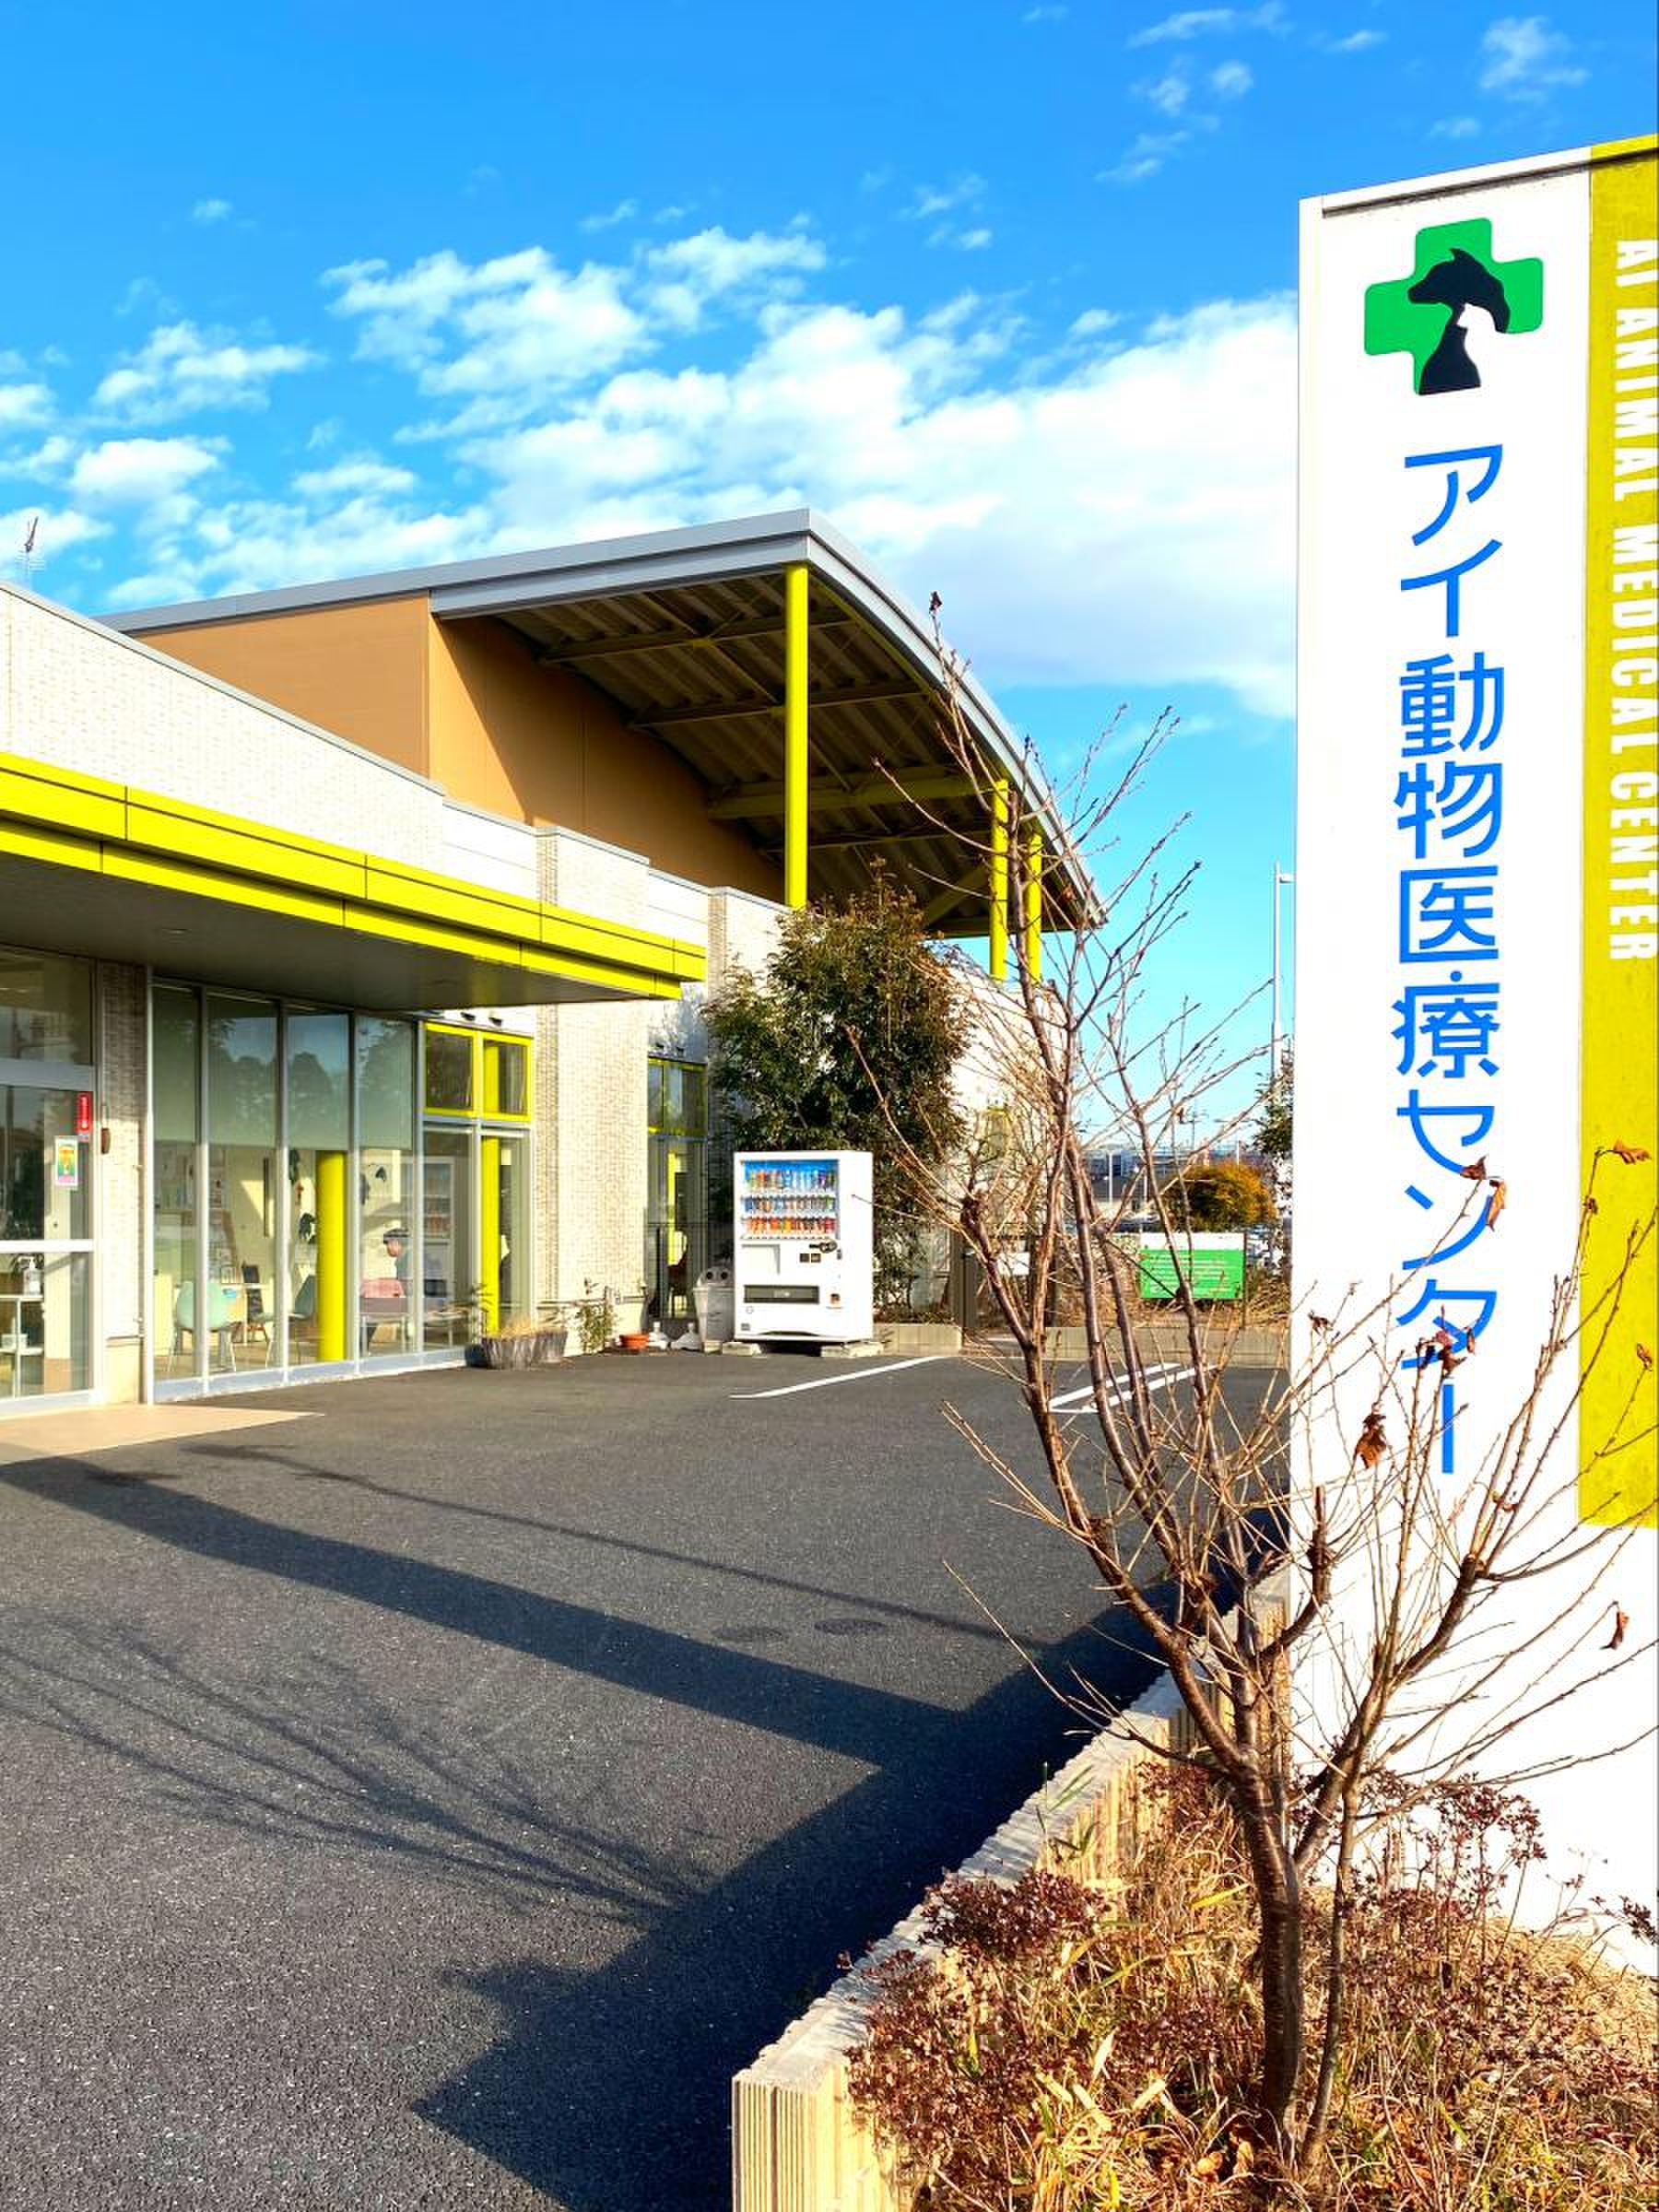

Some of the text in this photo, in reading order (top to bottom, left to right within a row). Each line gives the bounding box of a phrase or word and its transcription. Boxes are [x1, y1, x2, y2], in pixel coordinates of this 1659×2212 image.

[1391, 444, 1505, 1475] アイ動物医療センター
[1608, 239, 1658, 959] AI ANIMAL MEDICAL CENTER
